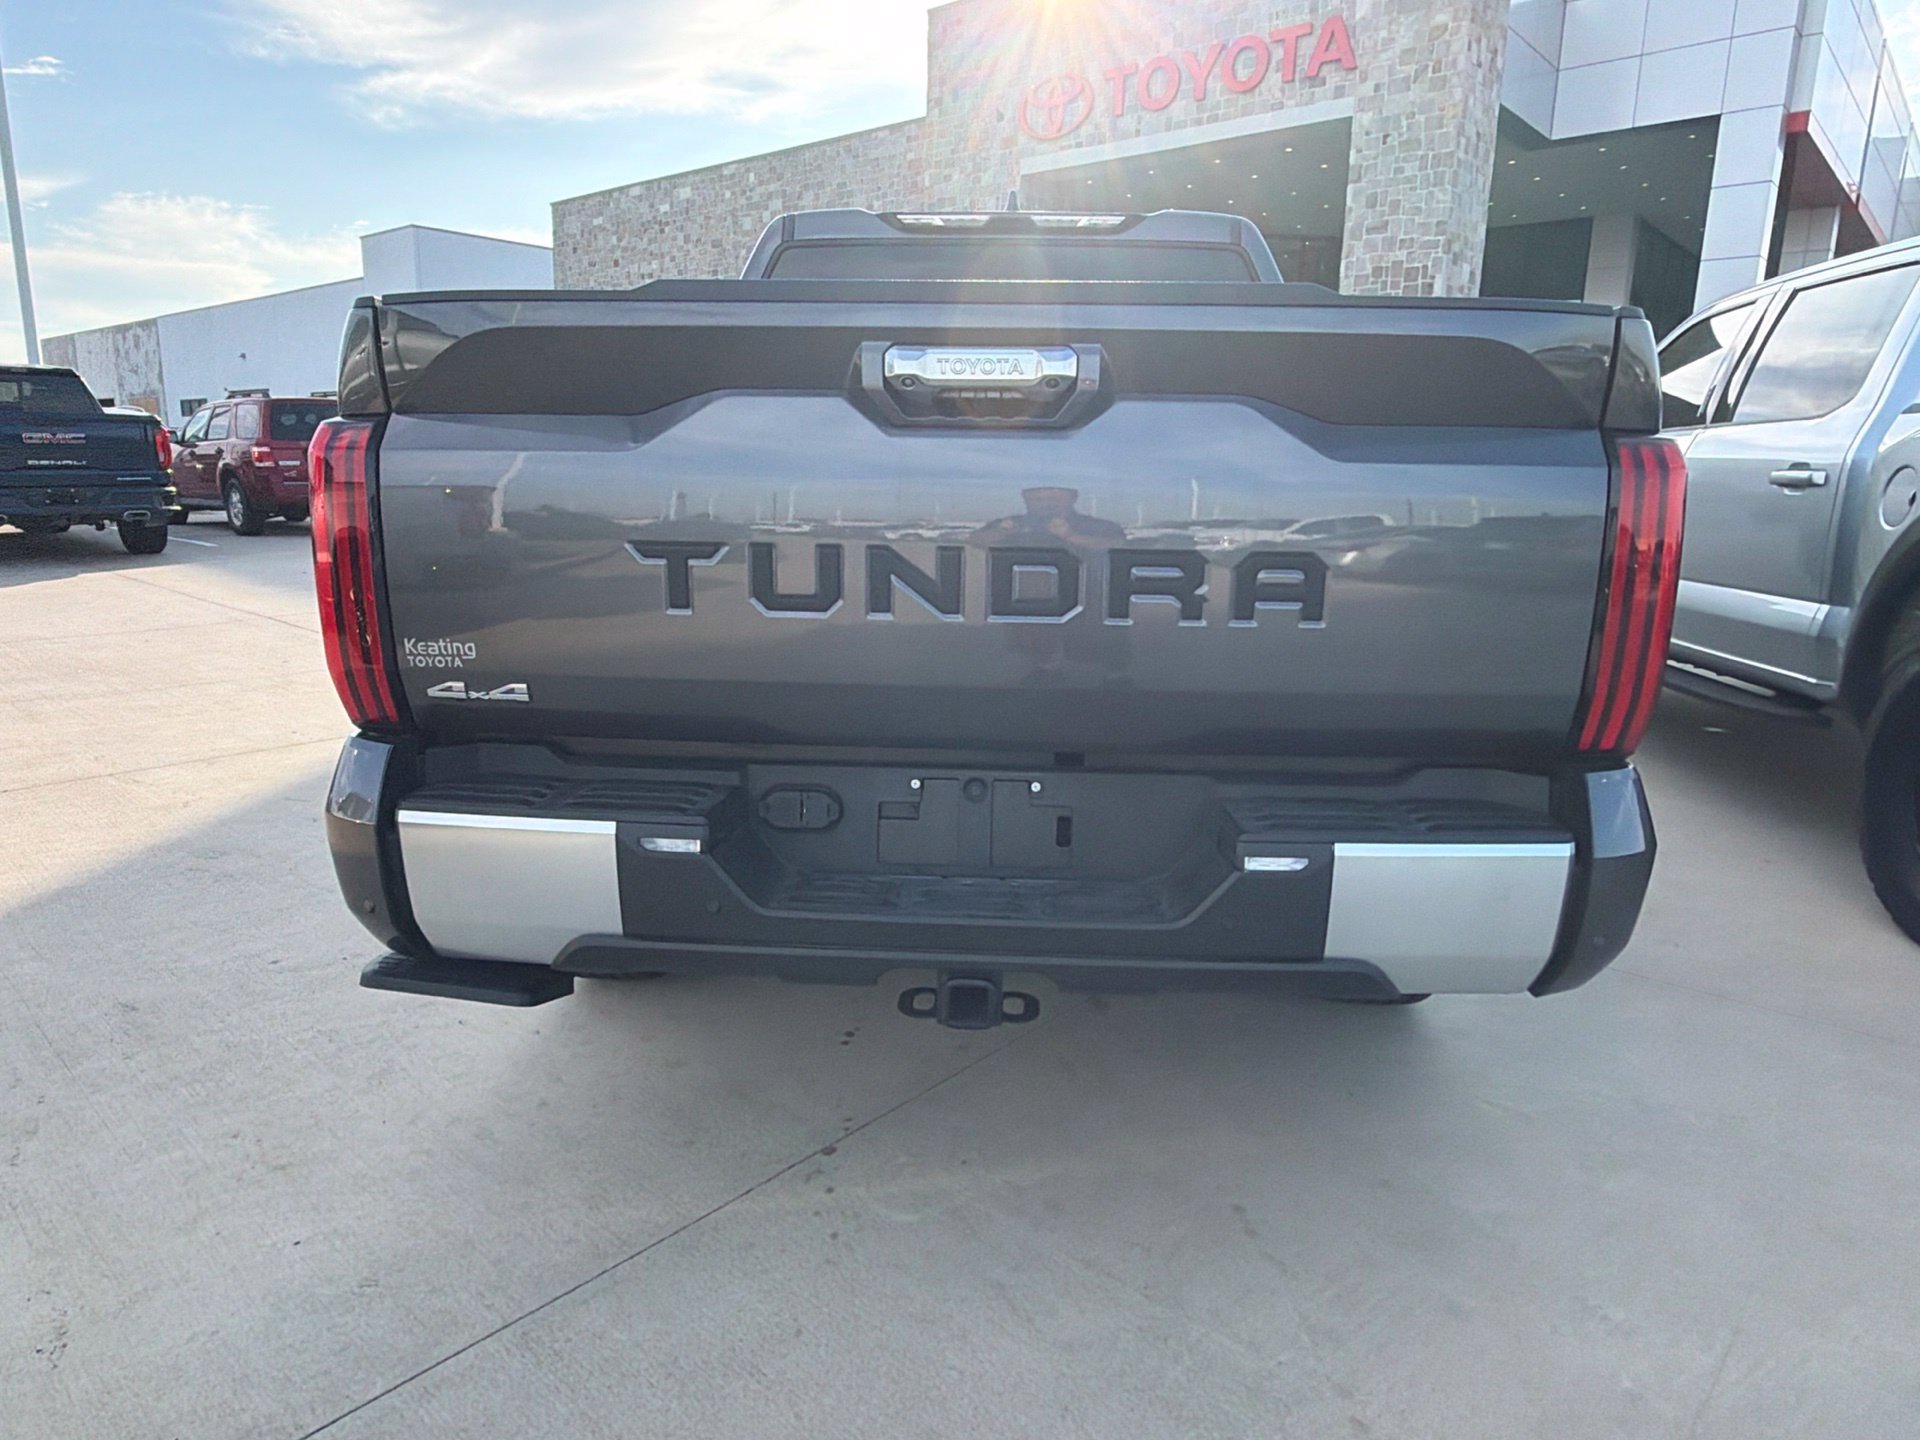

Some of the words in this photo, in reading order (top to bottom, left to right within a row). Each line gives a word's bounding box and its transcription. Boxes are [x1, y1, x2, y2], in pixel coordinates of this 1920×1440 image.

[1104, 14, 1358, 117] TOYOTA
[936, 357, 1024, 376] TOYOTA
[22, 432, 87, 444] GMC
[624, 539, 1330, 629] TUNDRA
[404, 637, 476, 660] Keating
[407, 656, 463, 668] TOYOTA
[426, 681, 530, 702] 4x4
